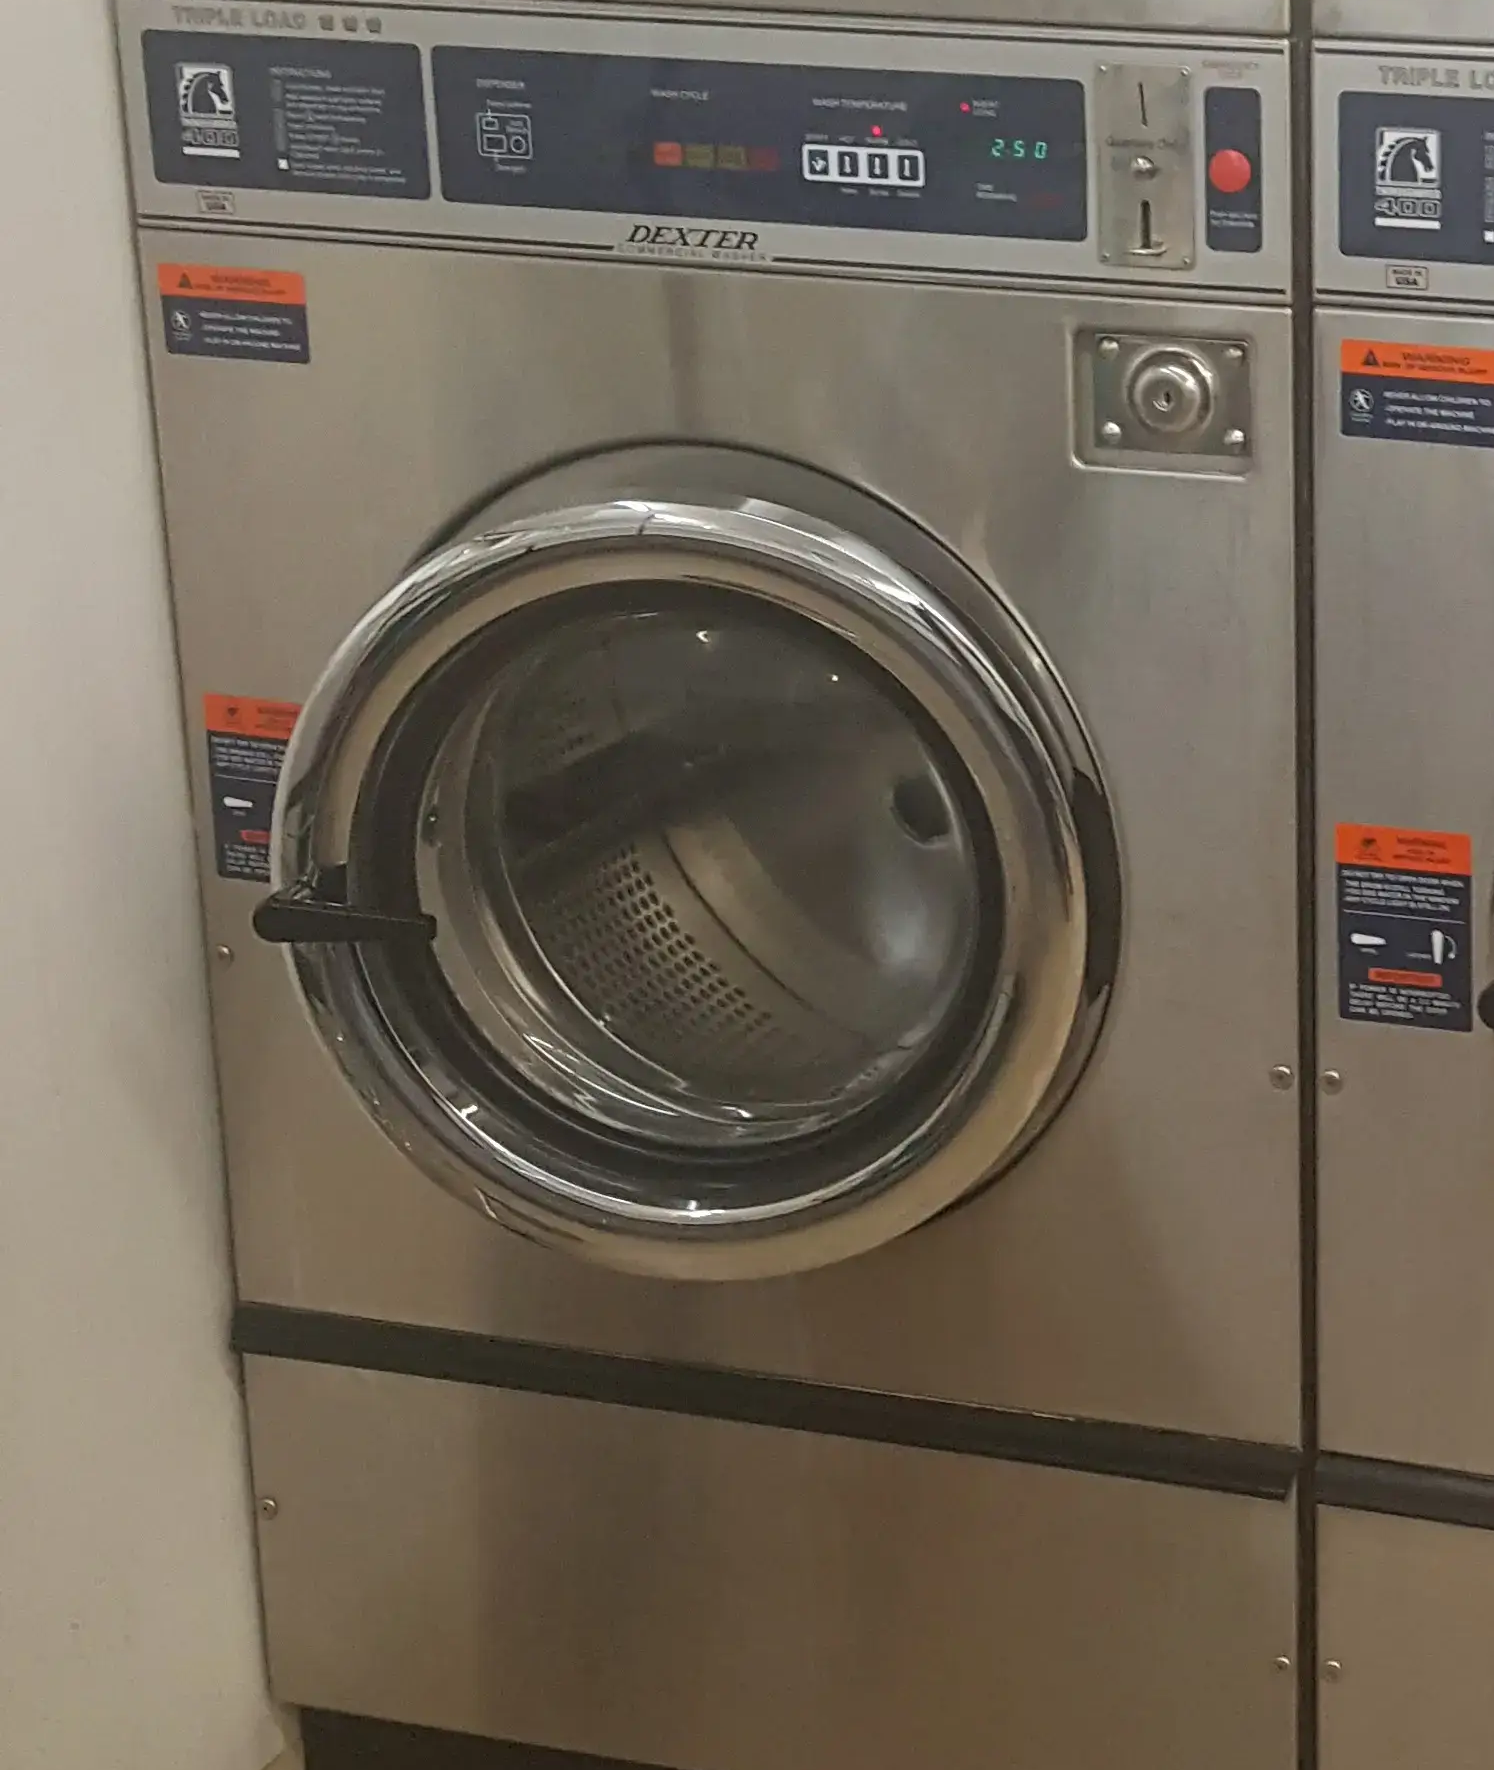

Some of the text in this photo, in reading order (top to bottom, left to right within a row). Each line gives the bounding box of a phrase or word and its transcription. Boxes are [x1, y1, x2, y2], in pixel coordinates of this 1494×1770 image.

[172, 5, 307, 30] TRIPLE LOAD
[1378, 65, 1461, 88] TRIPLE
[1374, 197, 1442, 218] 400
[626, 224, 759, 249] DEXTER
